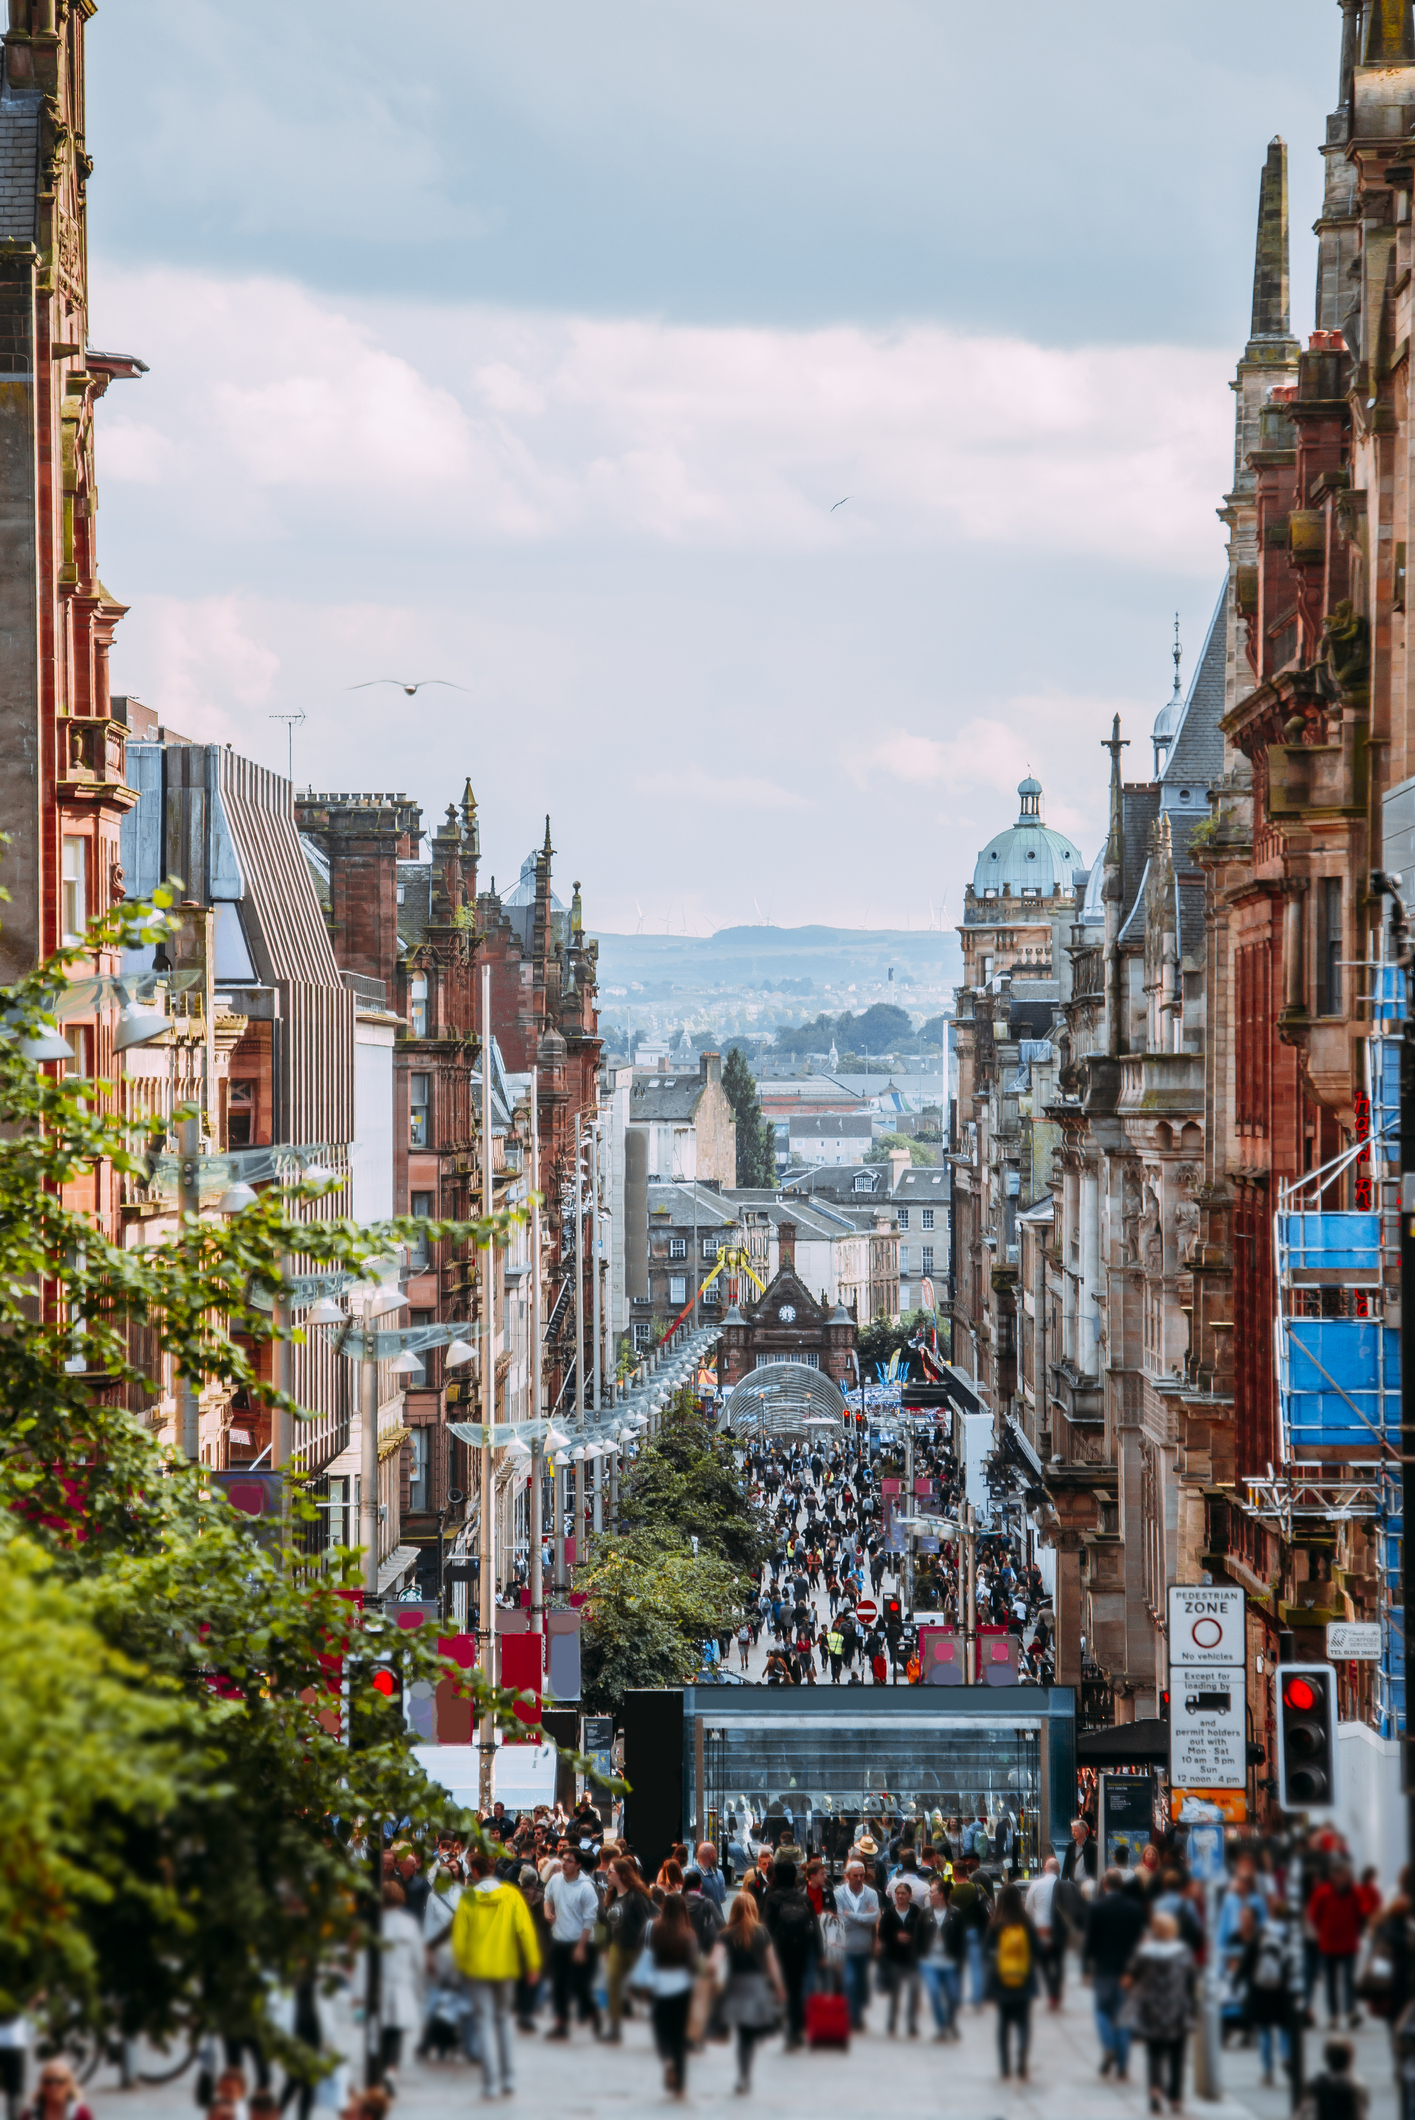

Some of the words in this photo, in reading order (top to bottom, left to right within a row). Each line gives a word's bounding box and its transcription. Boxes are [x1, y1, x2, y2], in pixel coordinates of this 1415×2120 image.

[1176, 1592, 1238, 1600] PEDESTRIAN
[1185, 1602, 1228, 1614] ZONE
[1185, 1672, 1214, 1681] Except
[1185, 1682, 1217, 1691] loading
[1220, 1682, 1230, 1691] by
[1208, 1729, 1240, 1737] holders
[1214, 1747, 1229, 1755] Sat
[1200, 1766, 1218, 1774] Sun
